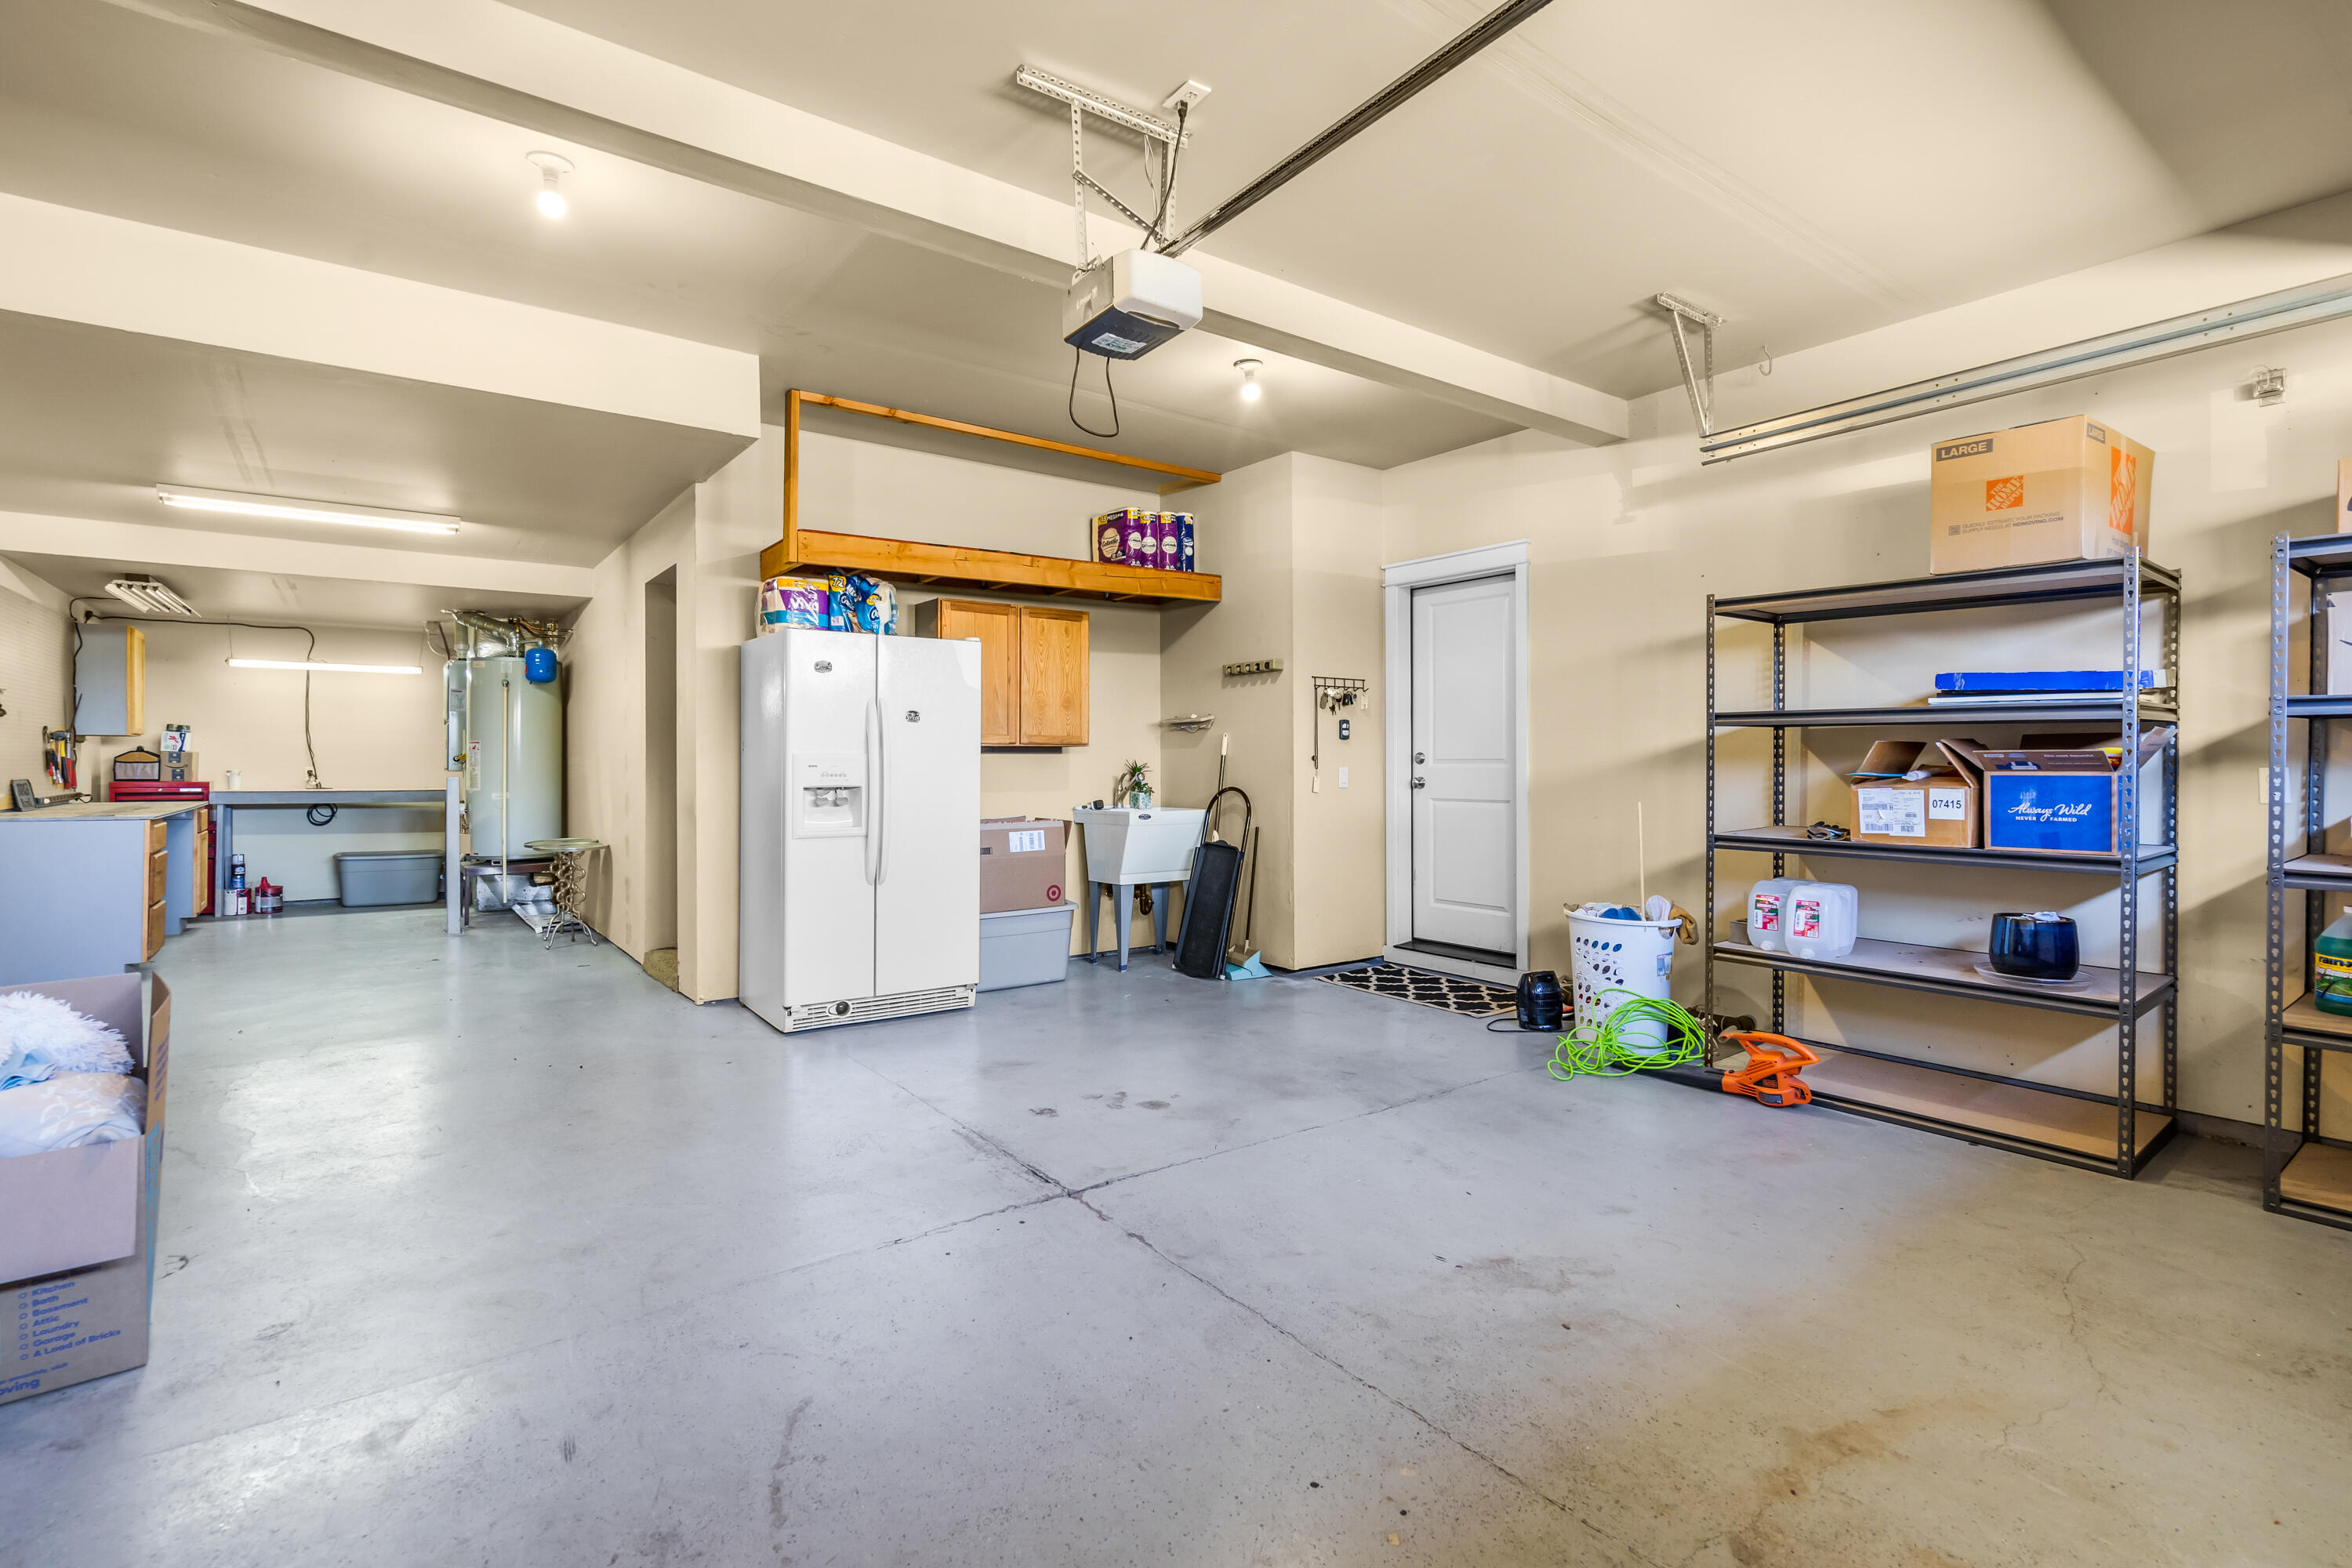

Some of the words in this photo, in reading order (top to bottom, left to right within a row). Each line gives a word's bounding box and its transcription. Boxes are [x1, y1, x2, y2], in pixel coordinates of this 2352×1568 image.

[2089, 424, 2104, 441] LARGE
[1941, 441, 1987, 459] LARGE
[1987, 477, 2022, 510] HOME
[1990, 482, 2004, 495] THE
[2000, 488, 2023, 509] DEPOT
[1962, 521, 1986, 529] QUICKLY
[1987, 517, 2014, 525] ESTIMATE
[2013, 516, 2064, 528] HDMOVING.COM
[833, 577, 844, 588] 72
[1933, 800, 1962, 809] 07415
[2008, 802, 2053, 822] Always
[2054, 803, 2092, 816] Wild
[31, 1281, 75, 1297] Kitchen
[32, 1295, 60, 1307] Bath
[32, 1298, 89, 1317] Basement
[32, 1316, 60, 1327] Attic
[32, 1320, 80, 1338] Laundry
[33, 1332, 76, 1347] Garage
[44, 1342, 73, 1355] Load
[74, 1338, 87, 1347] of
[88, 1329, 122, 1343] Bricks
